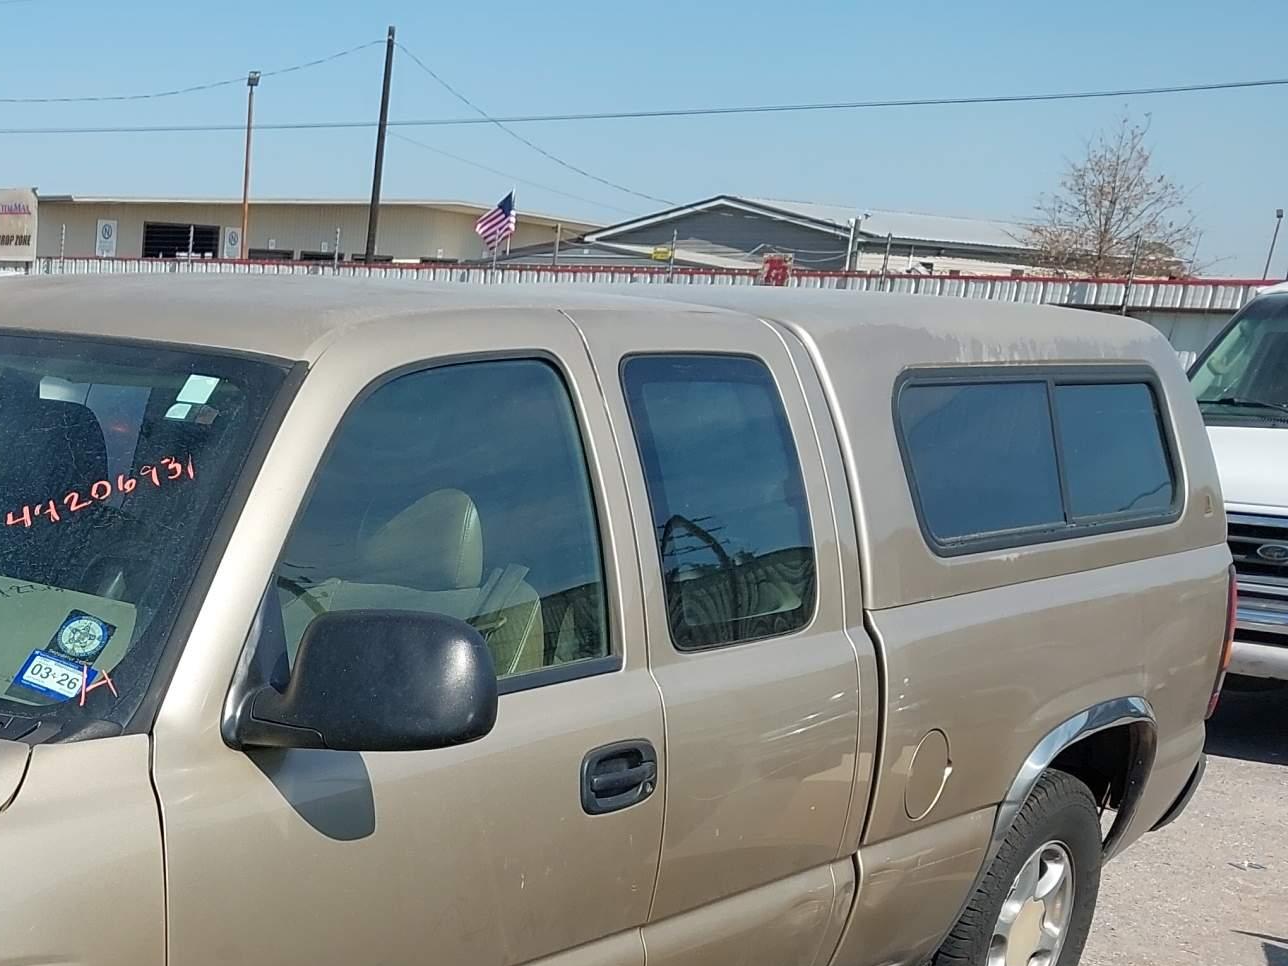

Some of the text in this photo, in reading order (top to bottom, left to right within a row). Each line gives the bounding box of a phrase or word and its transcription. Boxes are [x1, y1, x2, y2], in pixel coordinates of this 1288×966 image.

[14, 235, 31, 246] ZONE
[5, 455, 196, 528] 44206931
[30, 663, 80, 690] 03 26
